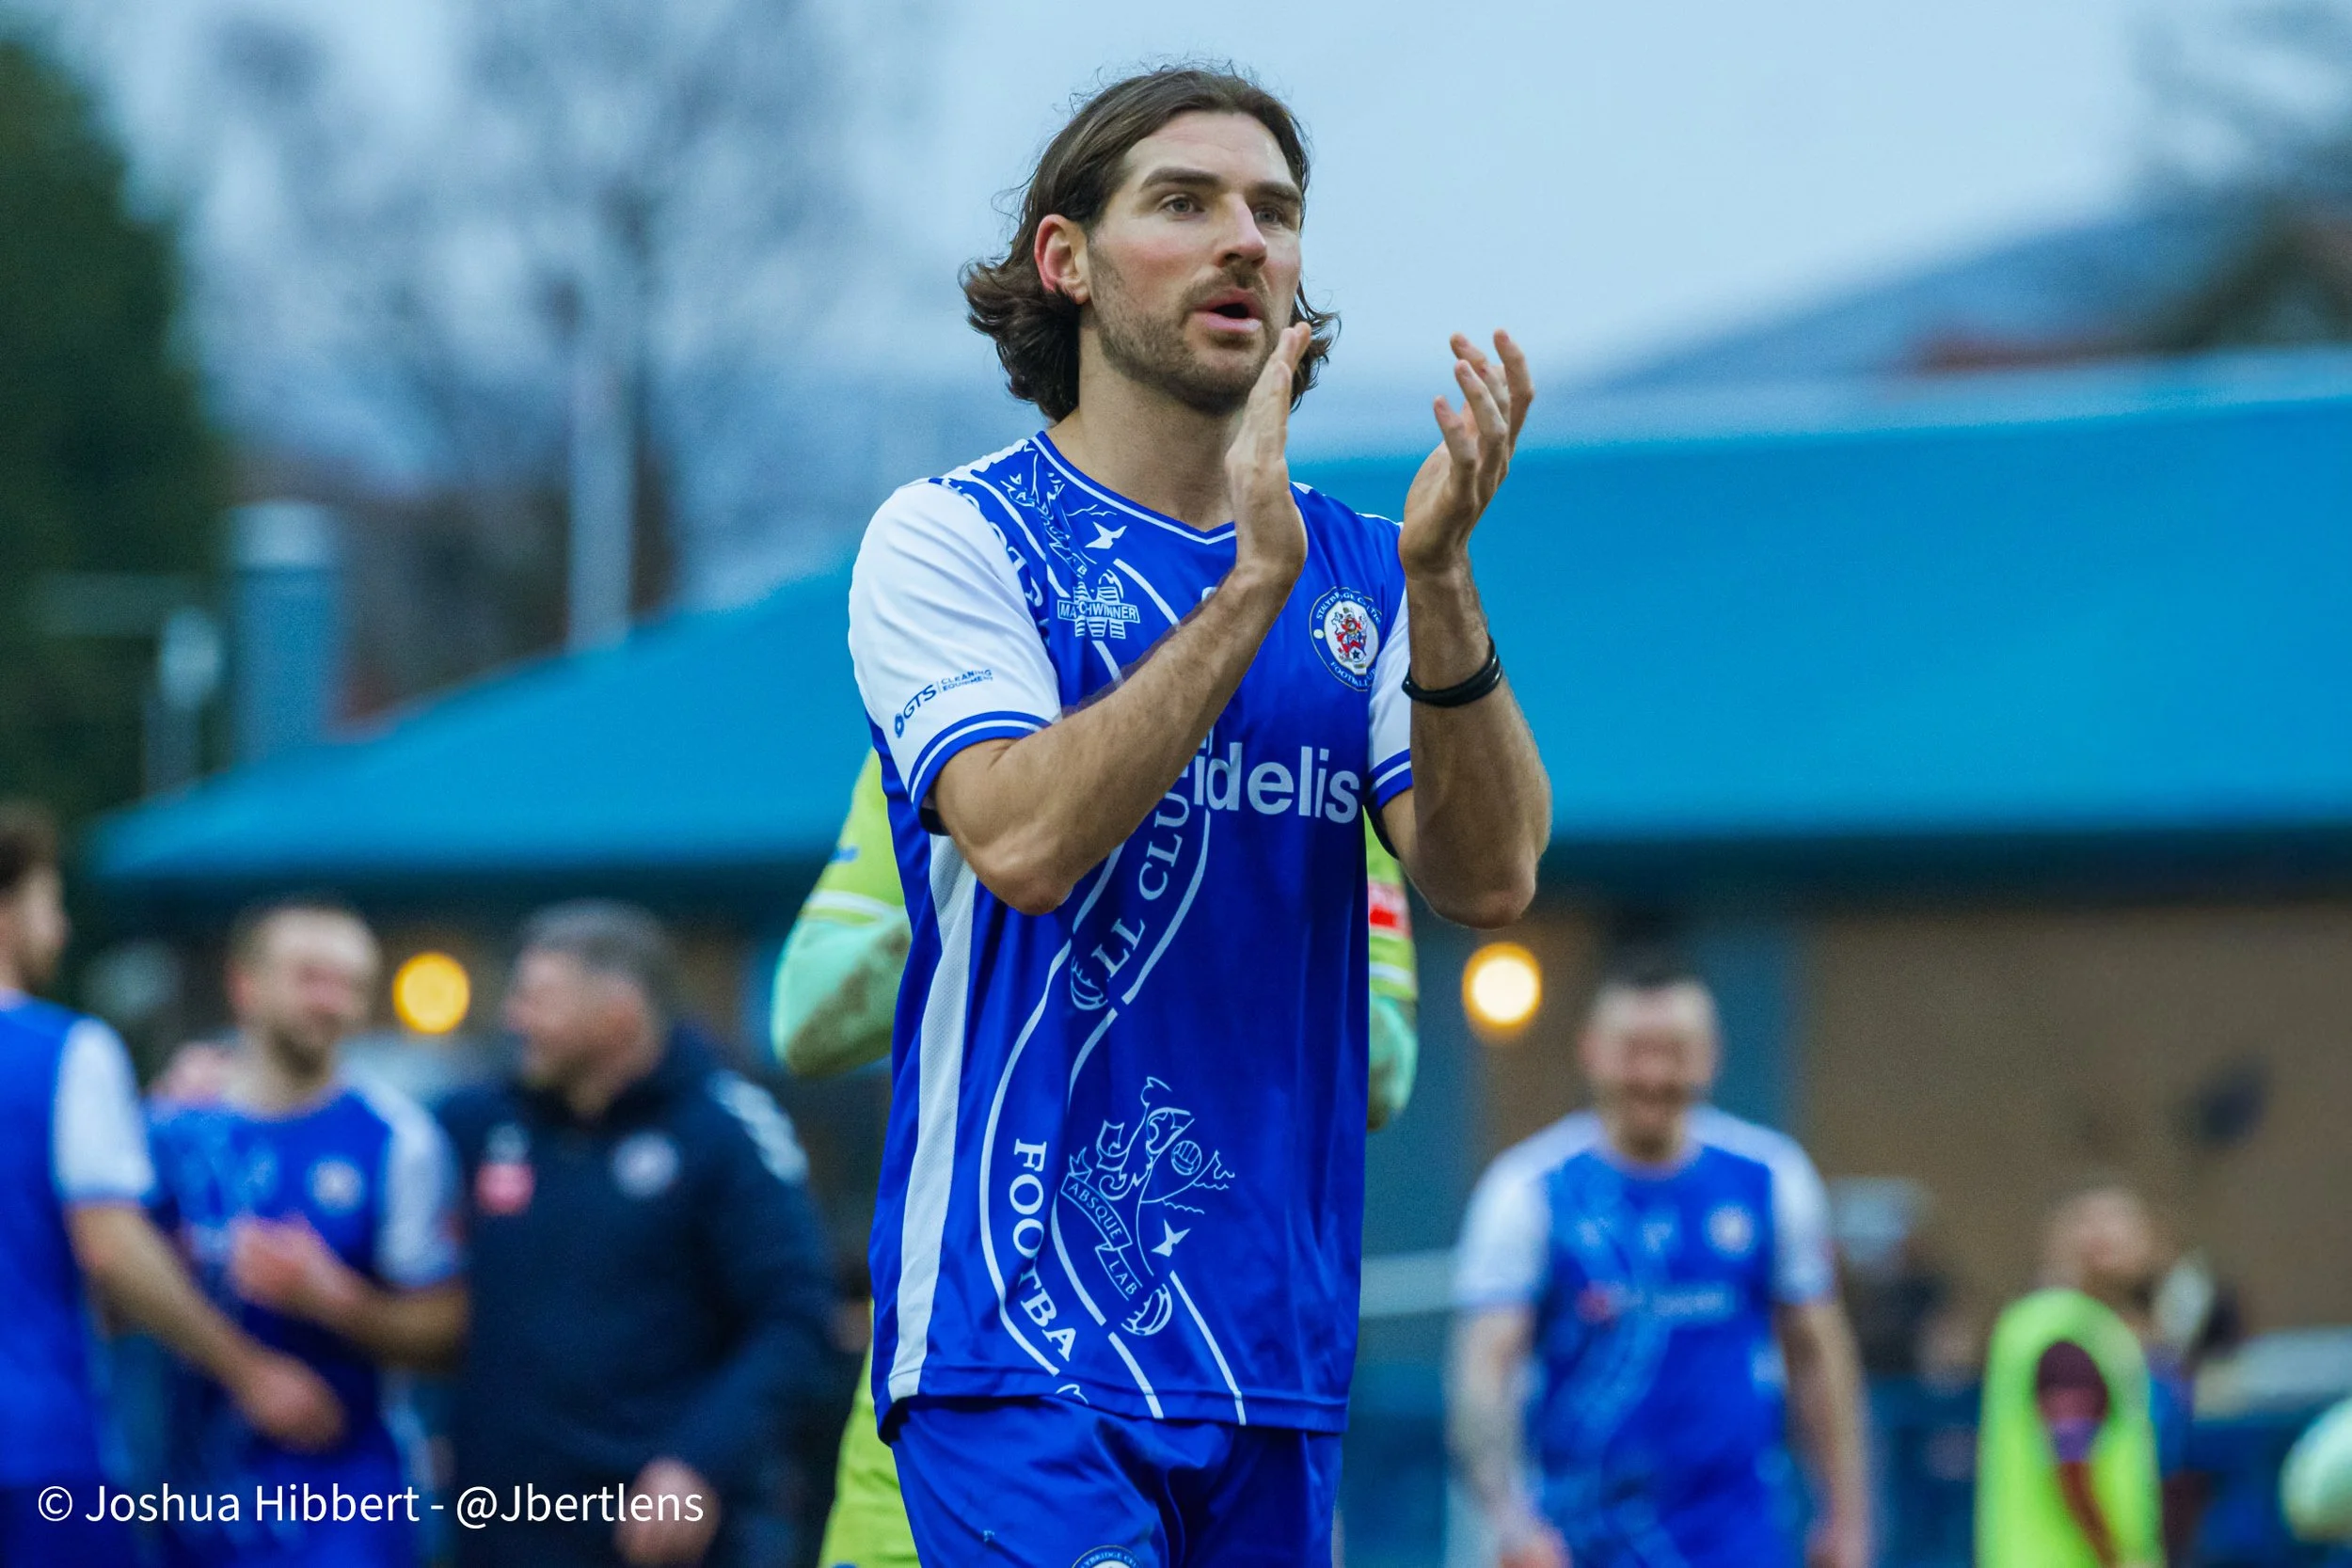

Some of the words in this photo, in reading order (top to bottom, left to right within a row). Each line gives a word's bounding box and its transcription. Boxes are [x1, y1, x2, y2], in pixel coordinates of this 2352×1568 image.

[1060, 601, 1136, 621] MACHWINNER
[903, 684, 937, 719] GTS
[1180, 742, 1360, 823] idelis
[1138, 793, 1190, 900] CLU
[1069, 1182, 1122, 1240] ABSQUE
[1108, 1259, 1137, 1295] LAB
